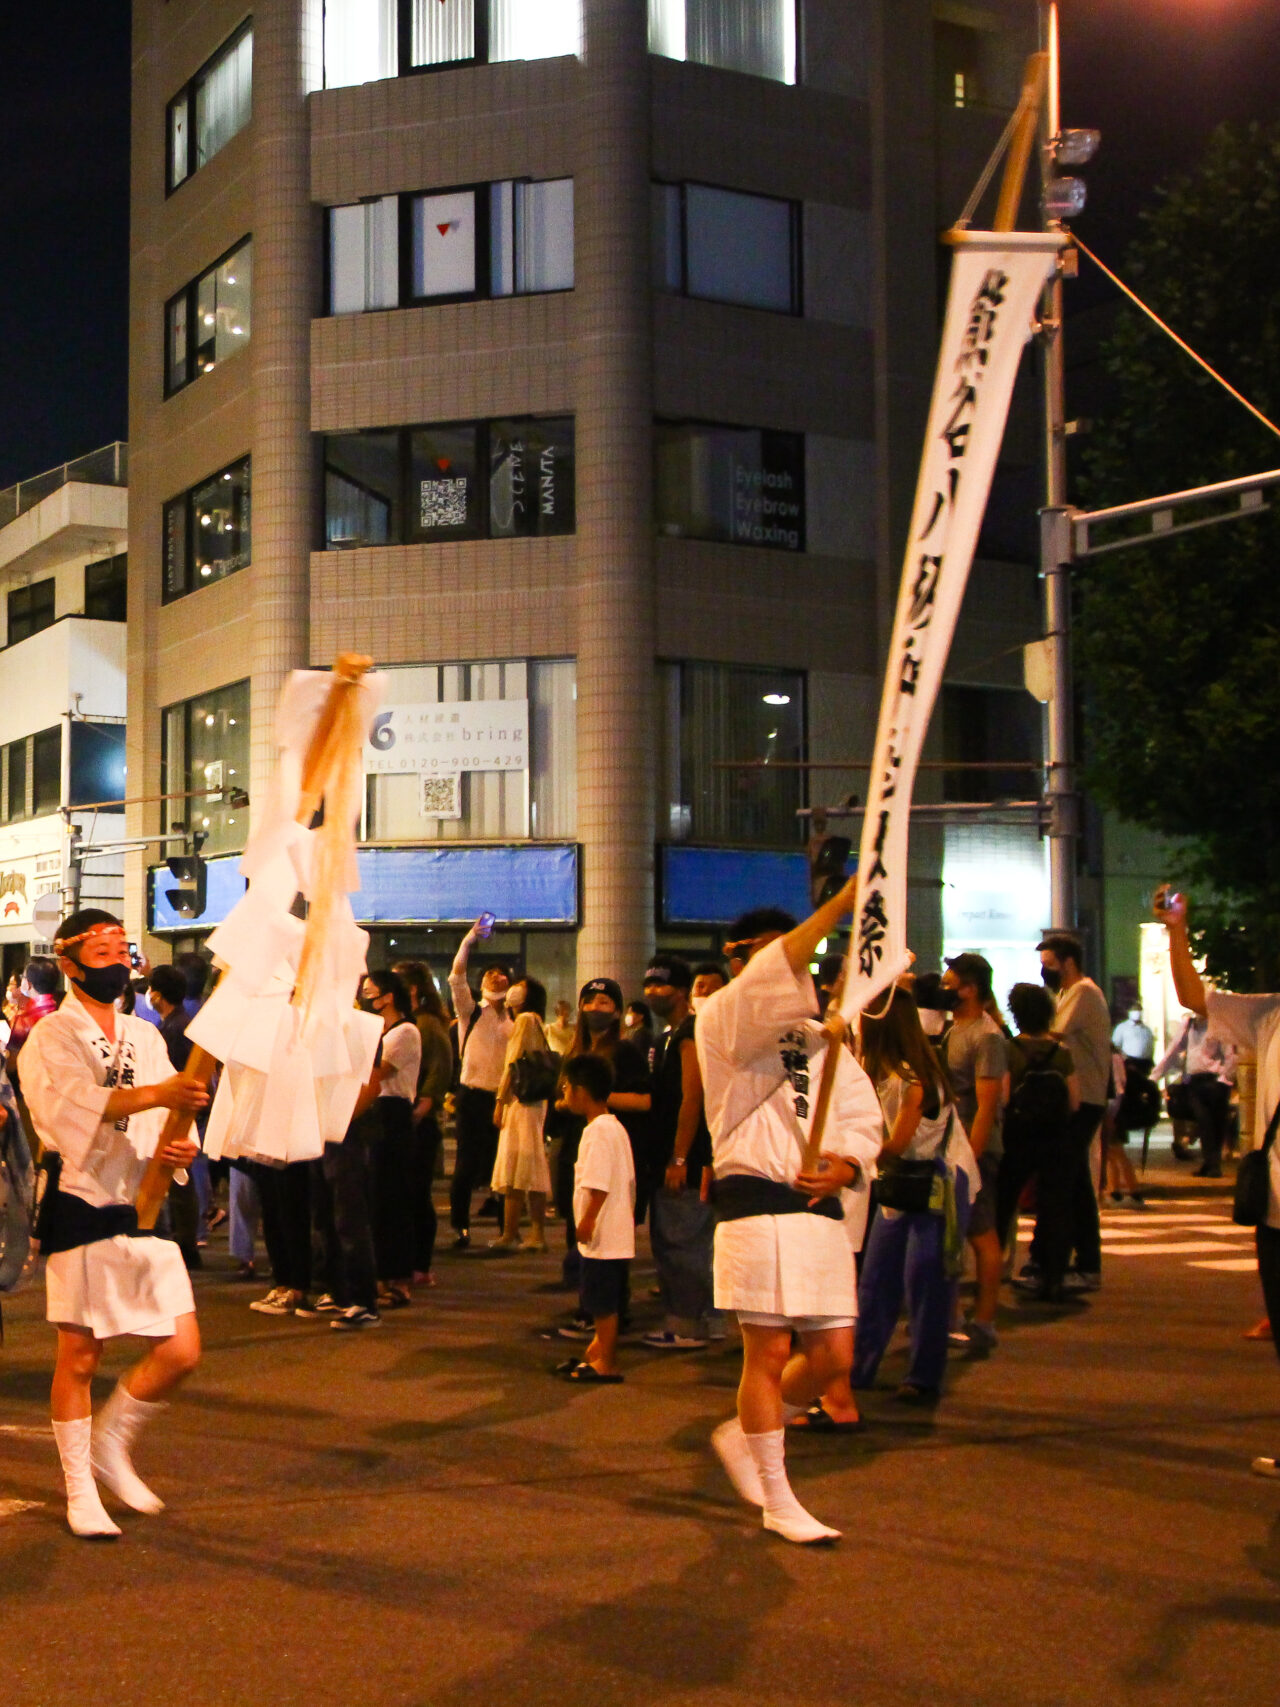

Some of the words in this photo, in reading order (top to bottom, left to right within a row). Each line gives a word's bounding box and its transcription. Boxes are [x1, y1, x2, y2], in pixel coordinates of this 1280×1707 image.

[736, 519, 799, 549] Waxing
[462, 726, 524, 743] bring
[368, 759, 394, 769] TEL
